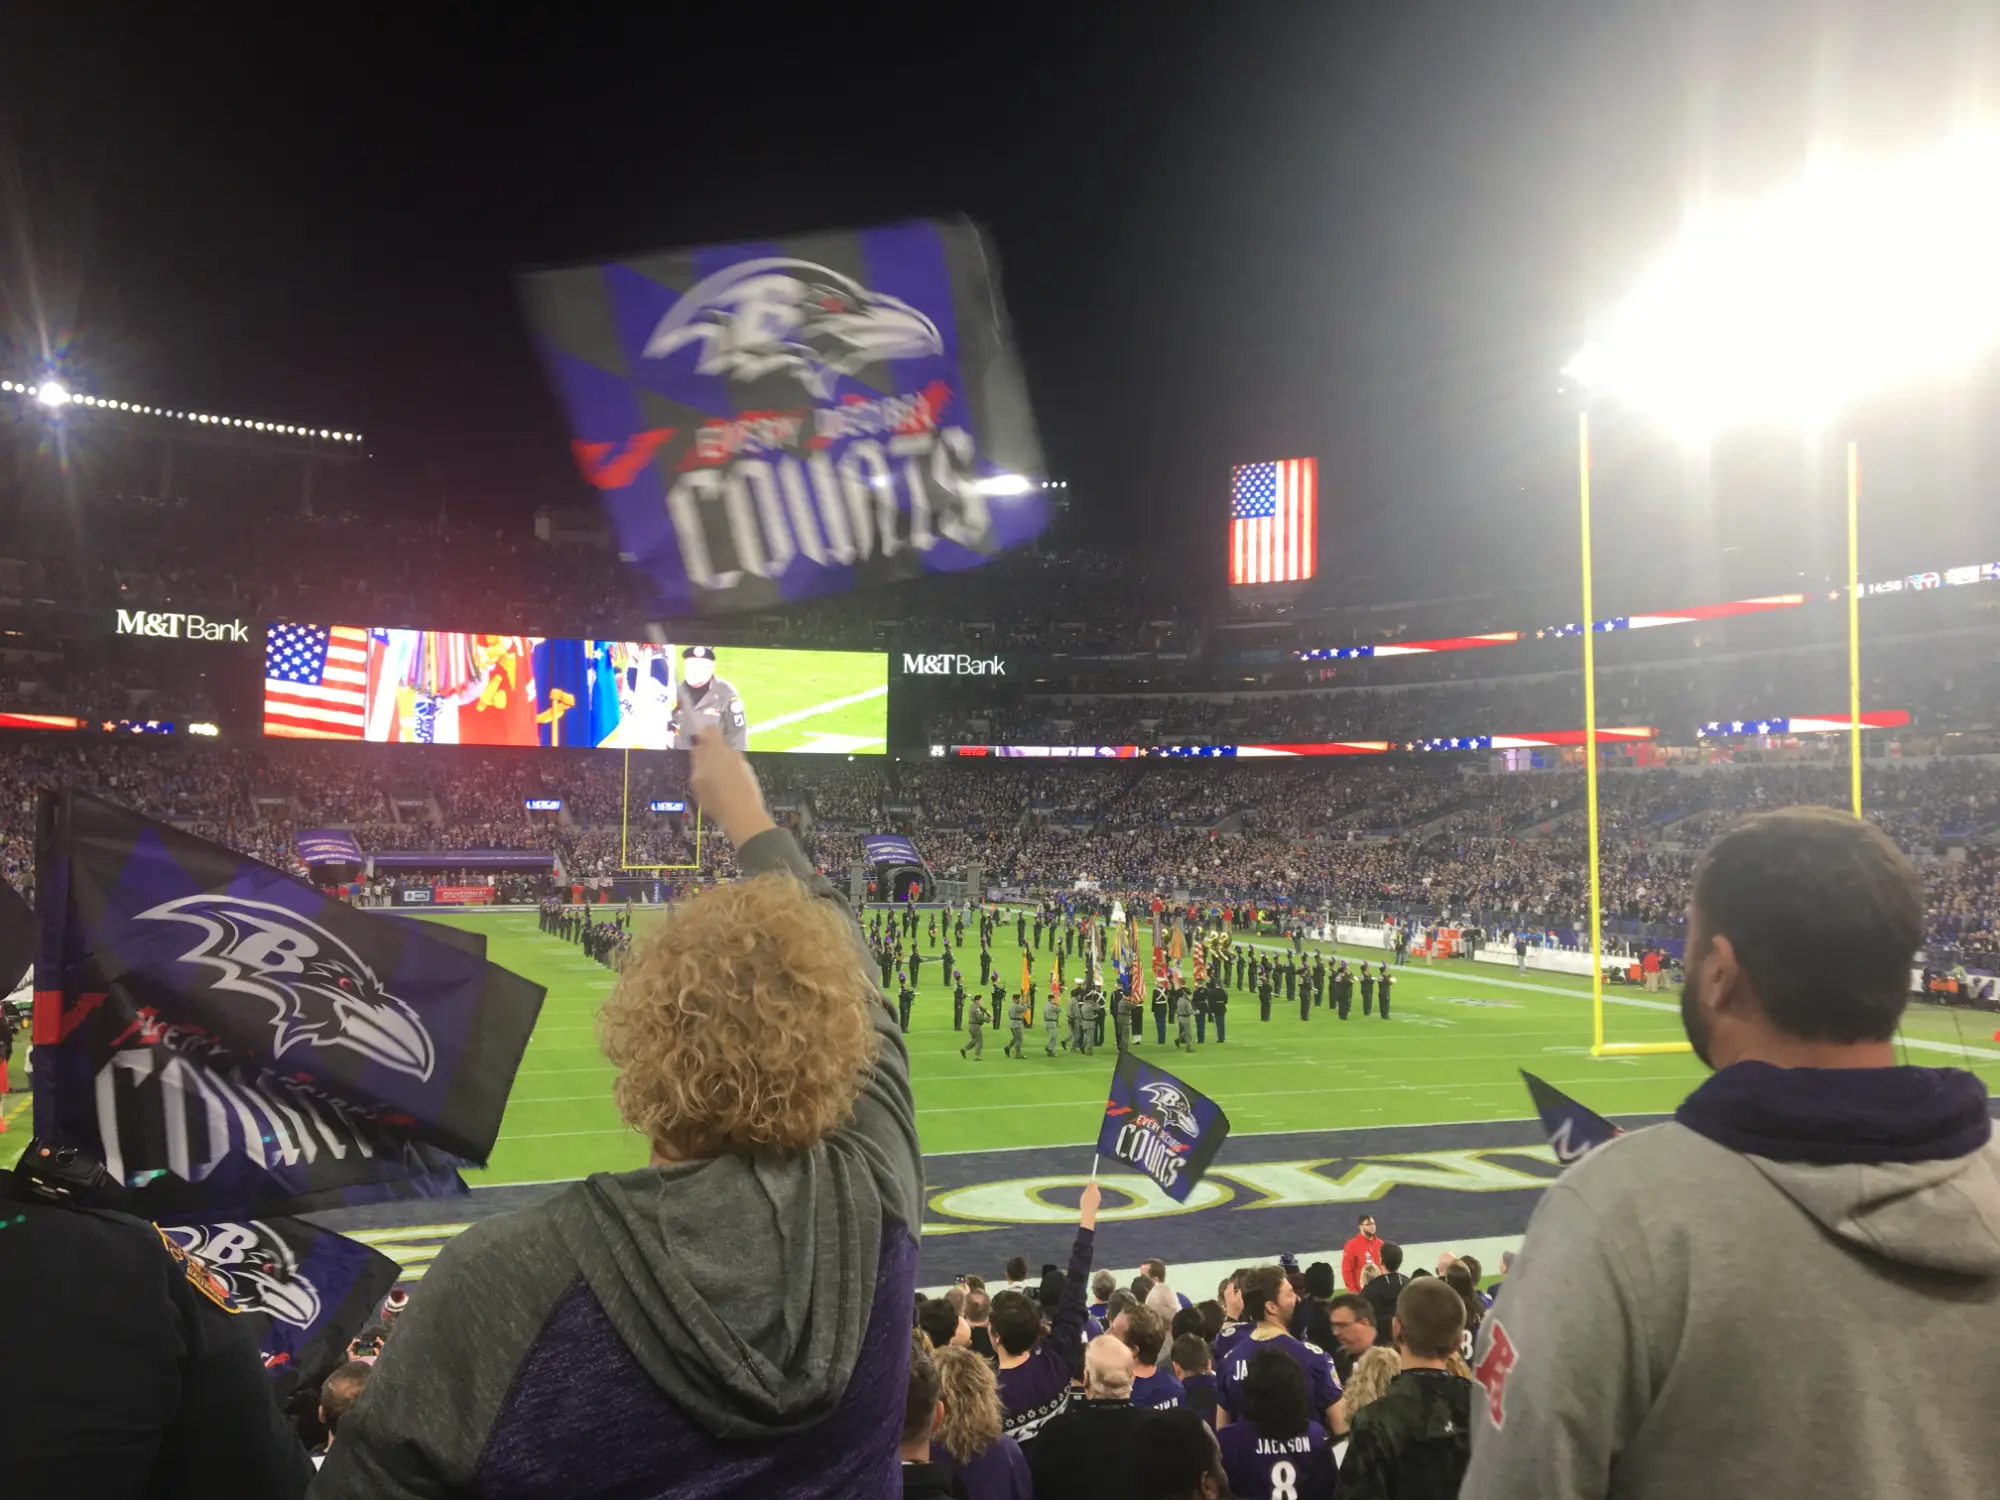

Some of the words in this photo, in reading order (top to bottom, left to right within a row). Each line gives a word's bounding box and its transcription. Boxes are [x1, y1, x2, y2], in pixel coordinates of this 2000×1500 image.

[115, 609, 186, 638] M&T
[187, 614, 249, 642] Bank
[902, 653, 956, 675] M&T
[956, 654, 1006, 675] Bank
[1114, 1123, 1188, 1188] COUNTS
[1271, 1460, 1298, 1500] 8
